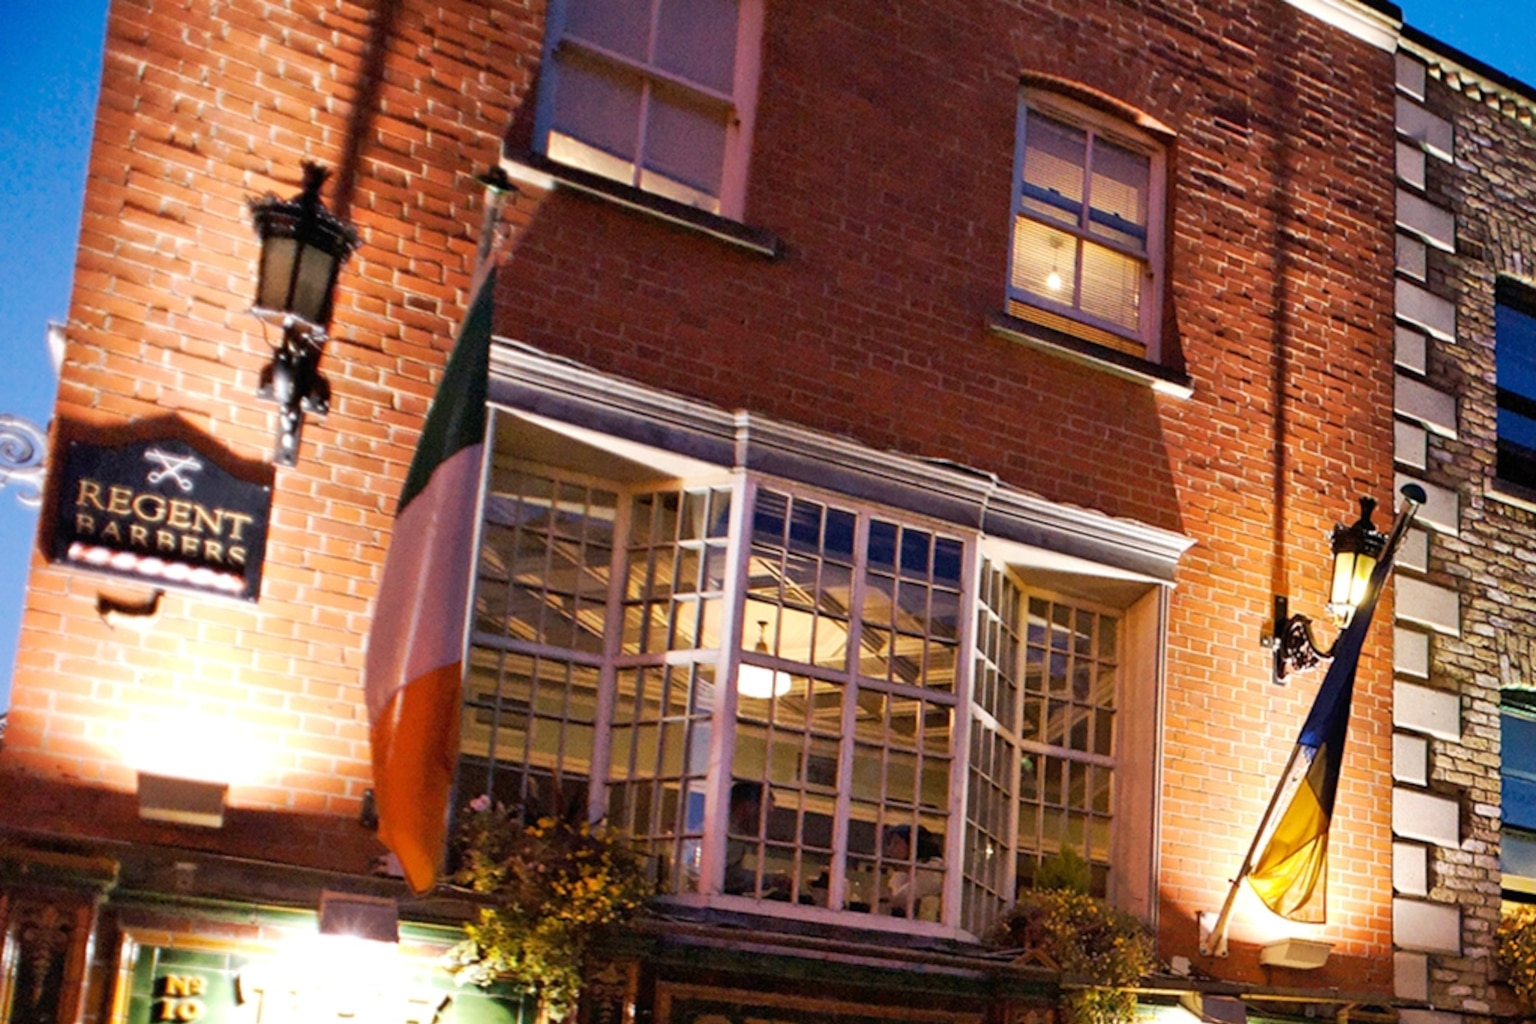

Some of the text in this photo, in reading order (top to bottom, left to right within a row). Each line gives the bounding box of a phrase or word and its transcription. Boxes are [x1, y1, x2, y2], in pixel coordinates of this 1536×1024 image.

[75, 478, 253, 540] REGENT
[76, 514, 246, 565] BARBERS
[161, 998, 201, 1022] 10
